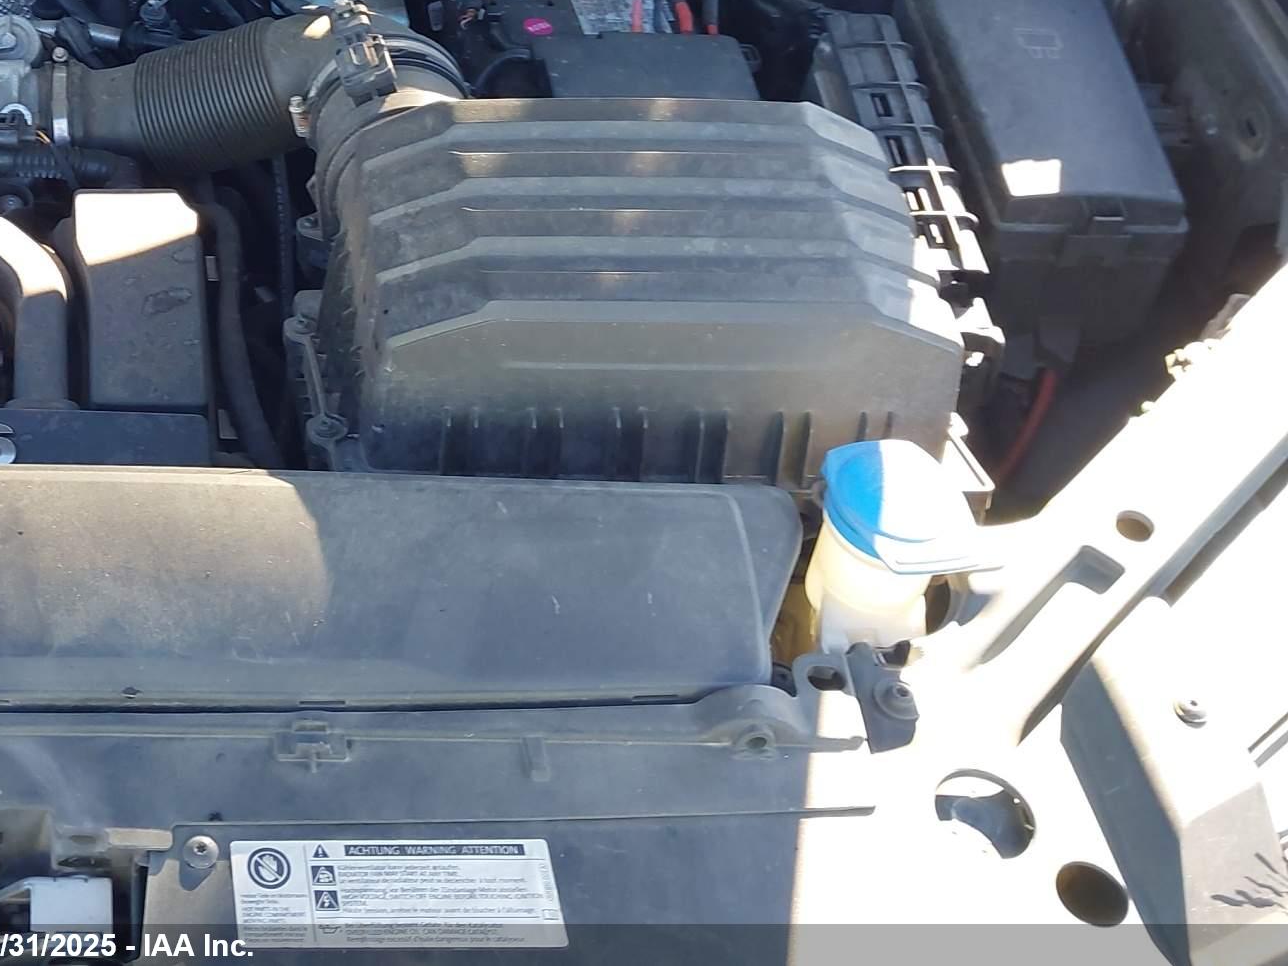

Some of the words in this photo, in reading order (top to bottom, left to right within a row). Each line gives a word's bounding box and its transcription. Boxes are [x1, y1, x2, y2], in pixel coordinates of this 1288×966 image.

[349, 846, 401, 856] ACHTUNG
[405, 846, 457, 855] WARNING
[461, 845, 519, 855] ATTENTION
